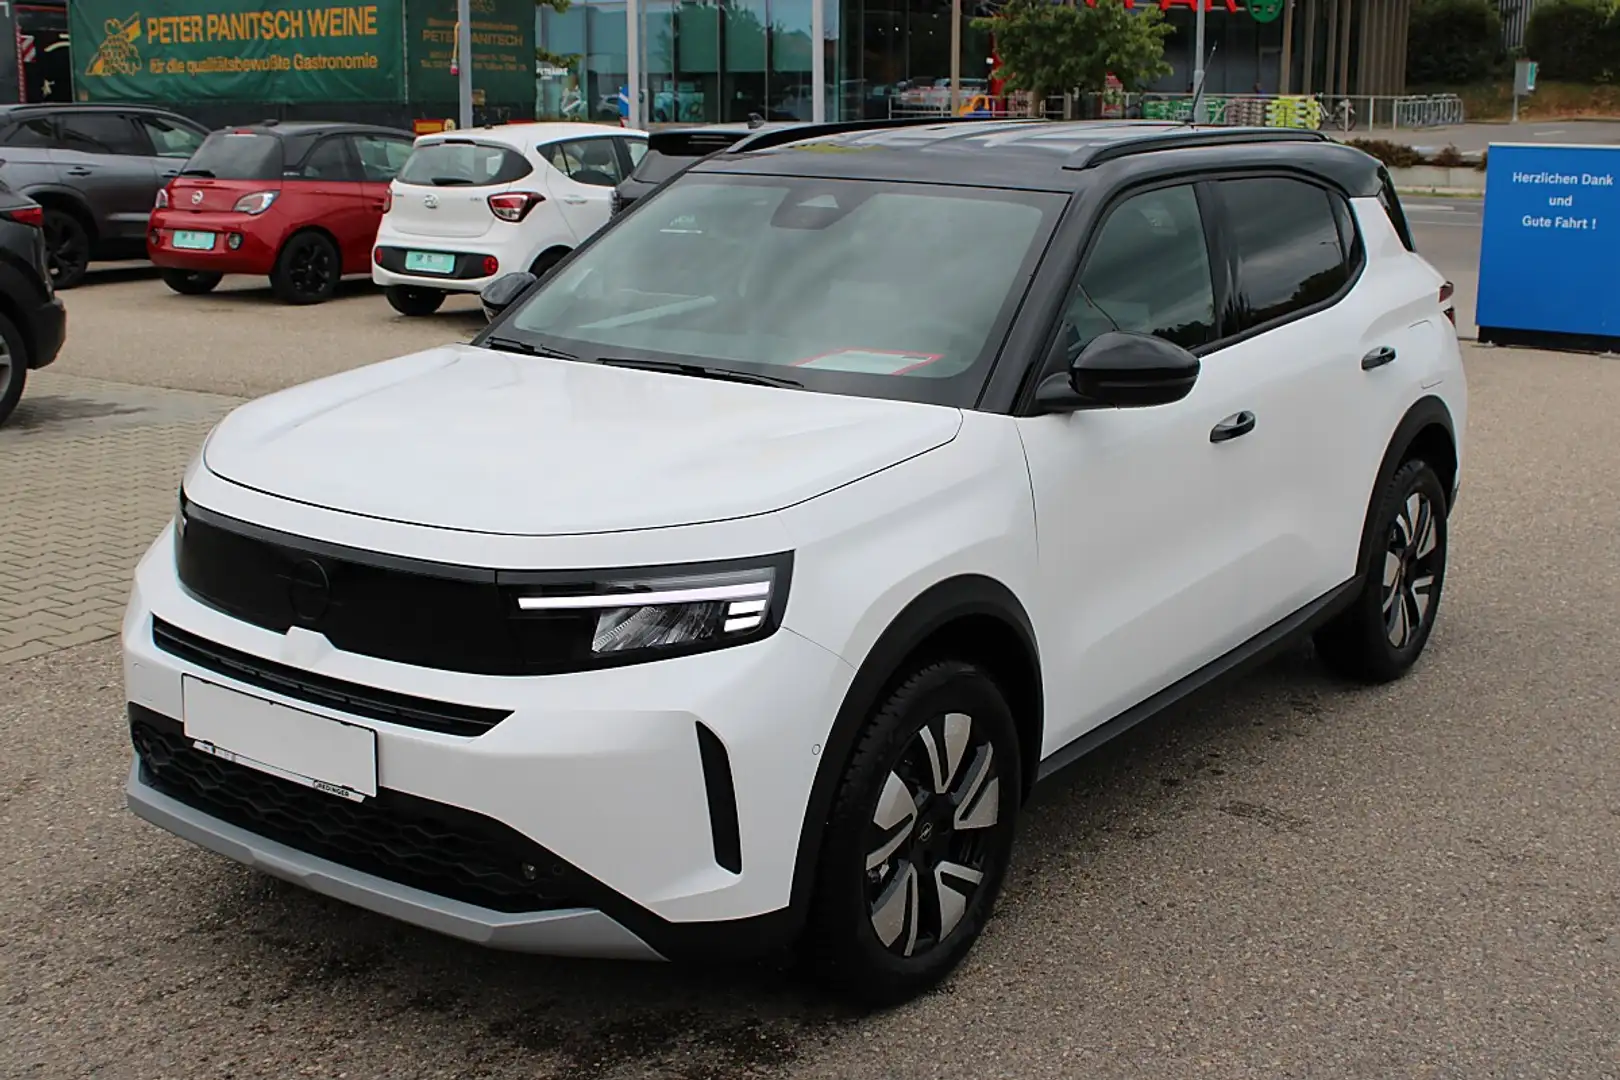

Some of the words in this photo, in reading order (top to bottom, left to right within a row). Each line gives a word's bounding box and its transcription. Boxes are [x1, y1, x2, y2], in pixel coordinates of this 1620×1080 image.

[147, 15, 204, 44] PETER
[206, 10, 304, 41] PANITSCH
[307, 6, 377, 36] WEINE
[422, 29, 457, 43] PETE
[167, 56, 185, 73] die
[293, 52, 378, 71] Gastronomie
[1512, 171, 1578, 185] Herzlichen
[1581, 173, 1614, 186] Dank
[1548, 195, 1573, 207] und
[1522, 215, 1552, 228] Gute
[1555, 216, 1588, 230] Fahrt
[1591, 218, 1597, 230] !
